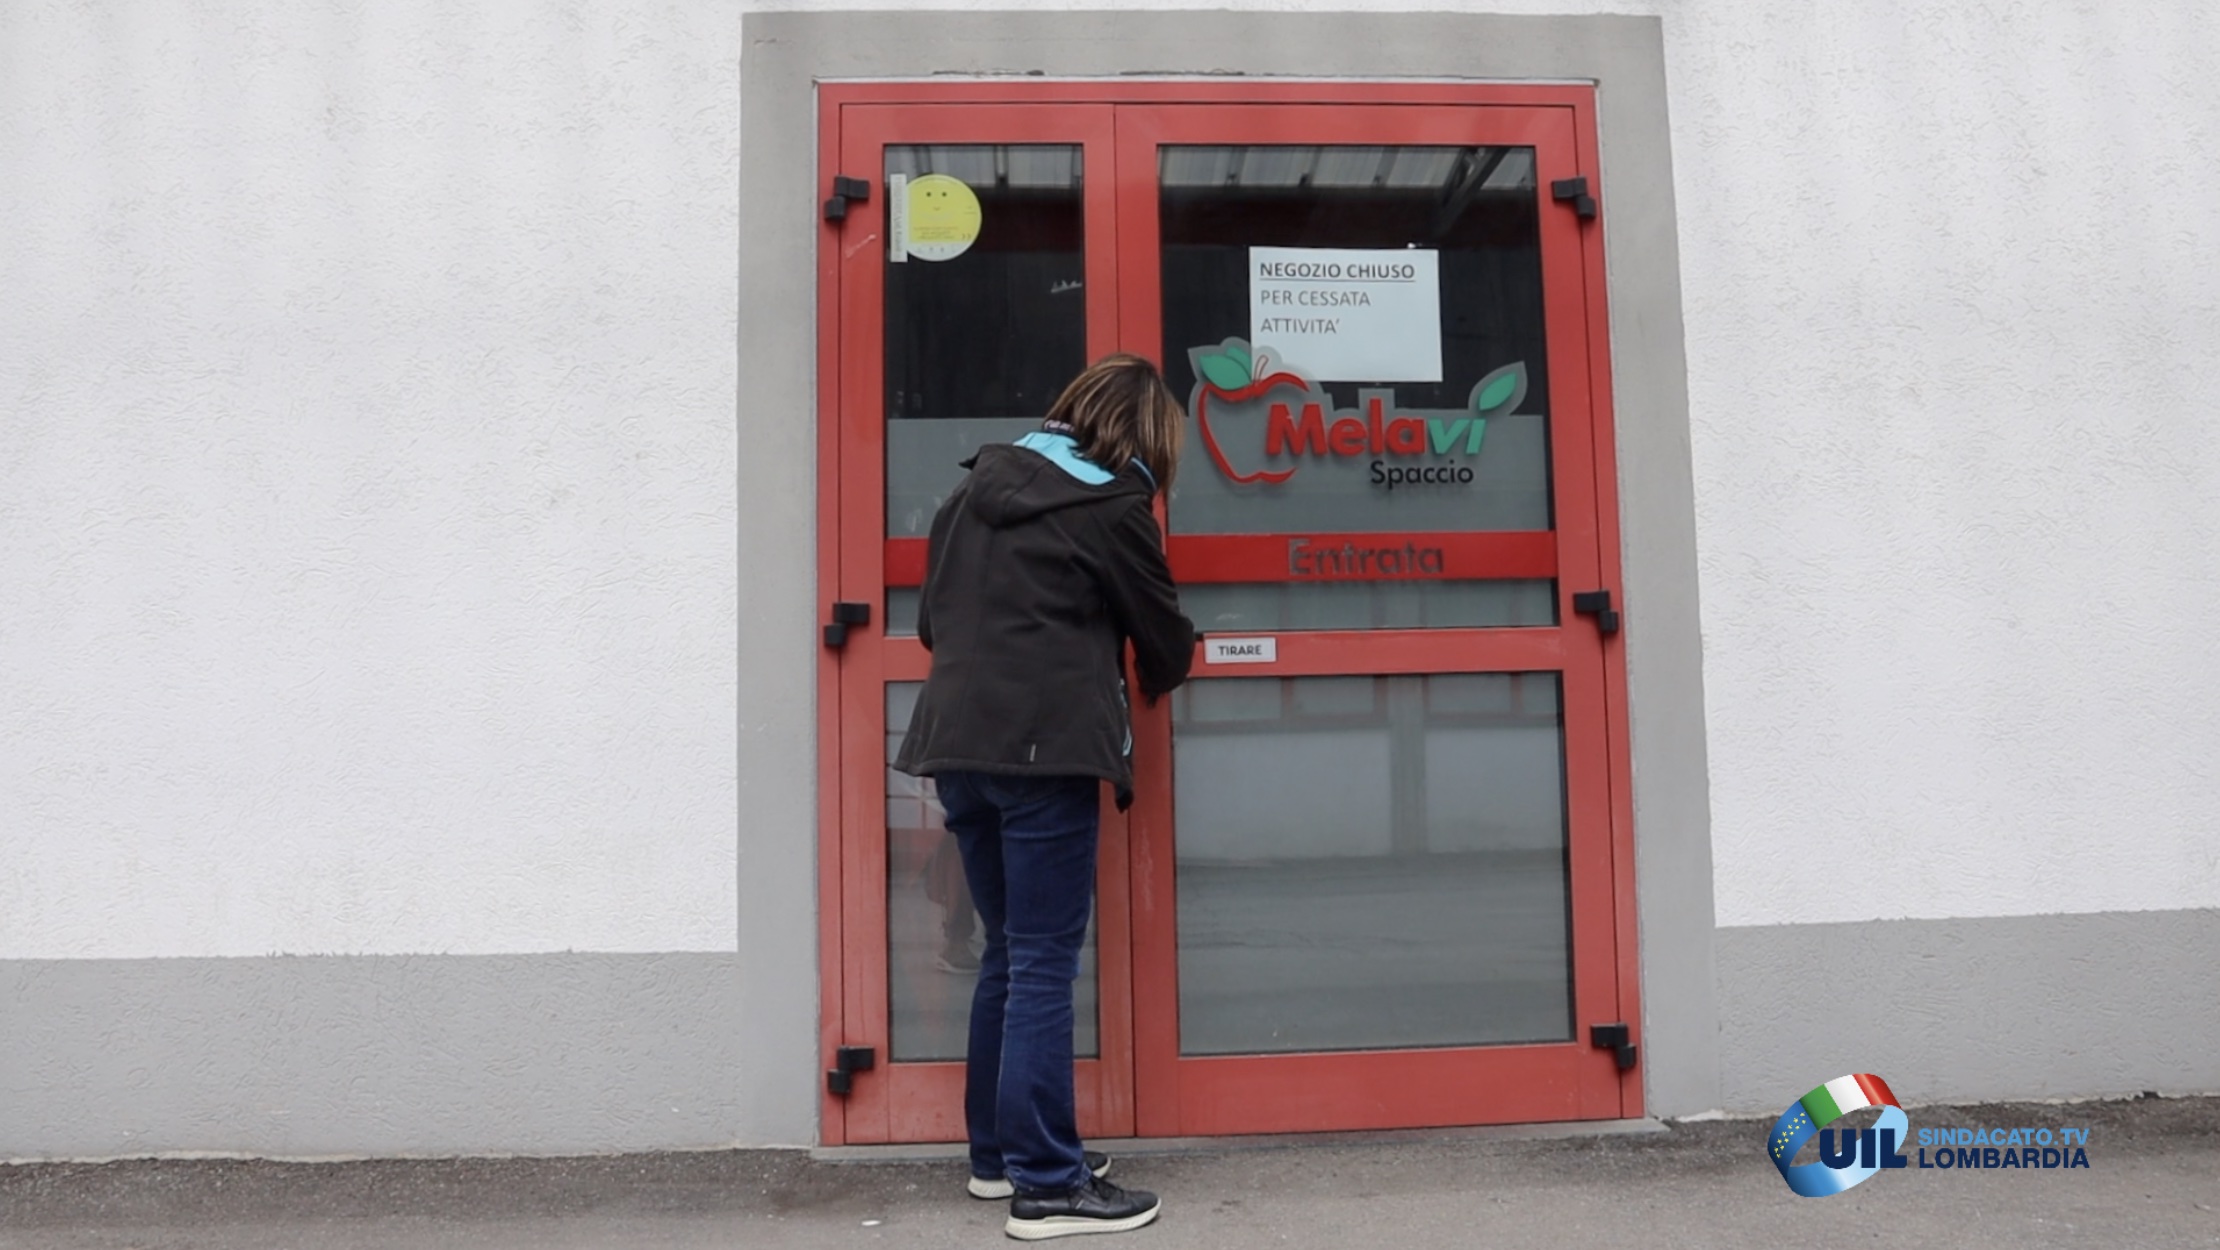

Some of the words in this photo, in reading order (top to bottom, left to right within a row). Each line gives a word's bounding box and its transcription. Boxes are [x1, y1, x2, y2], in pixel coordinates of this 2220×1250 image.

[1259, 262, 1341, 279] NEGOZIO
[1346, 263, 1415, 279] CHIUSO
[1260, 290, 1293, 306] PER
[1298, 290, 1371, 307] CESSATA
[1370, 460, 1474, 489] Spaccio
[1288, 539, 1444, 575] Entrata
[1218, 645, 1263, 657] TIRARE
